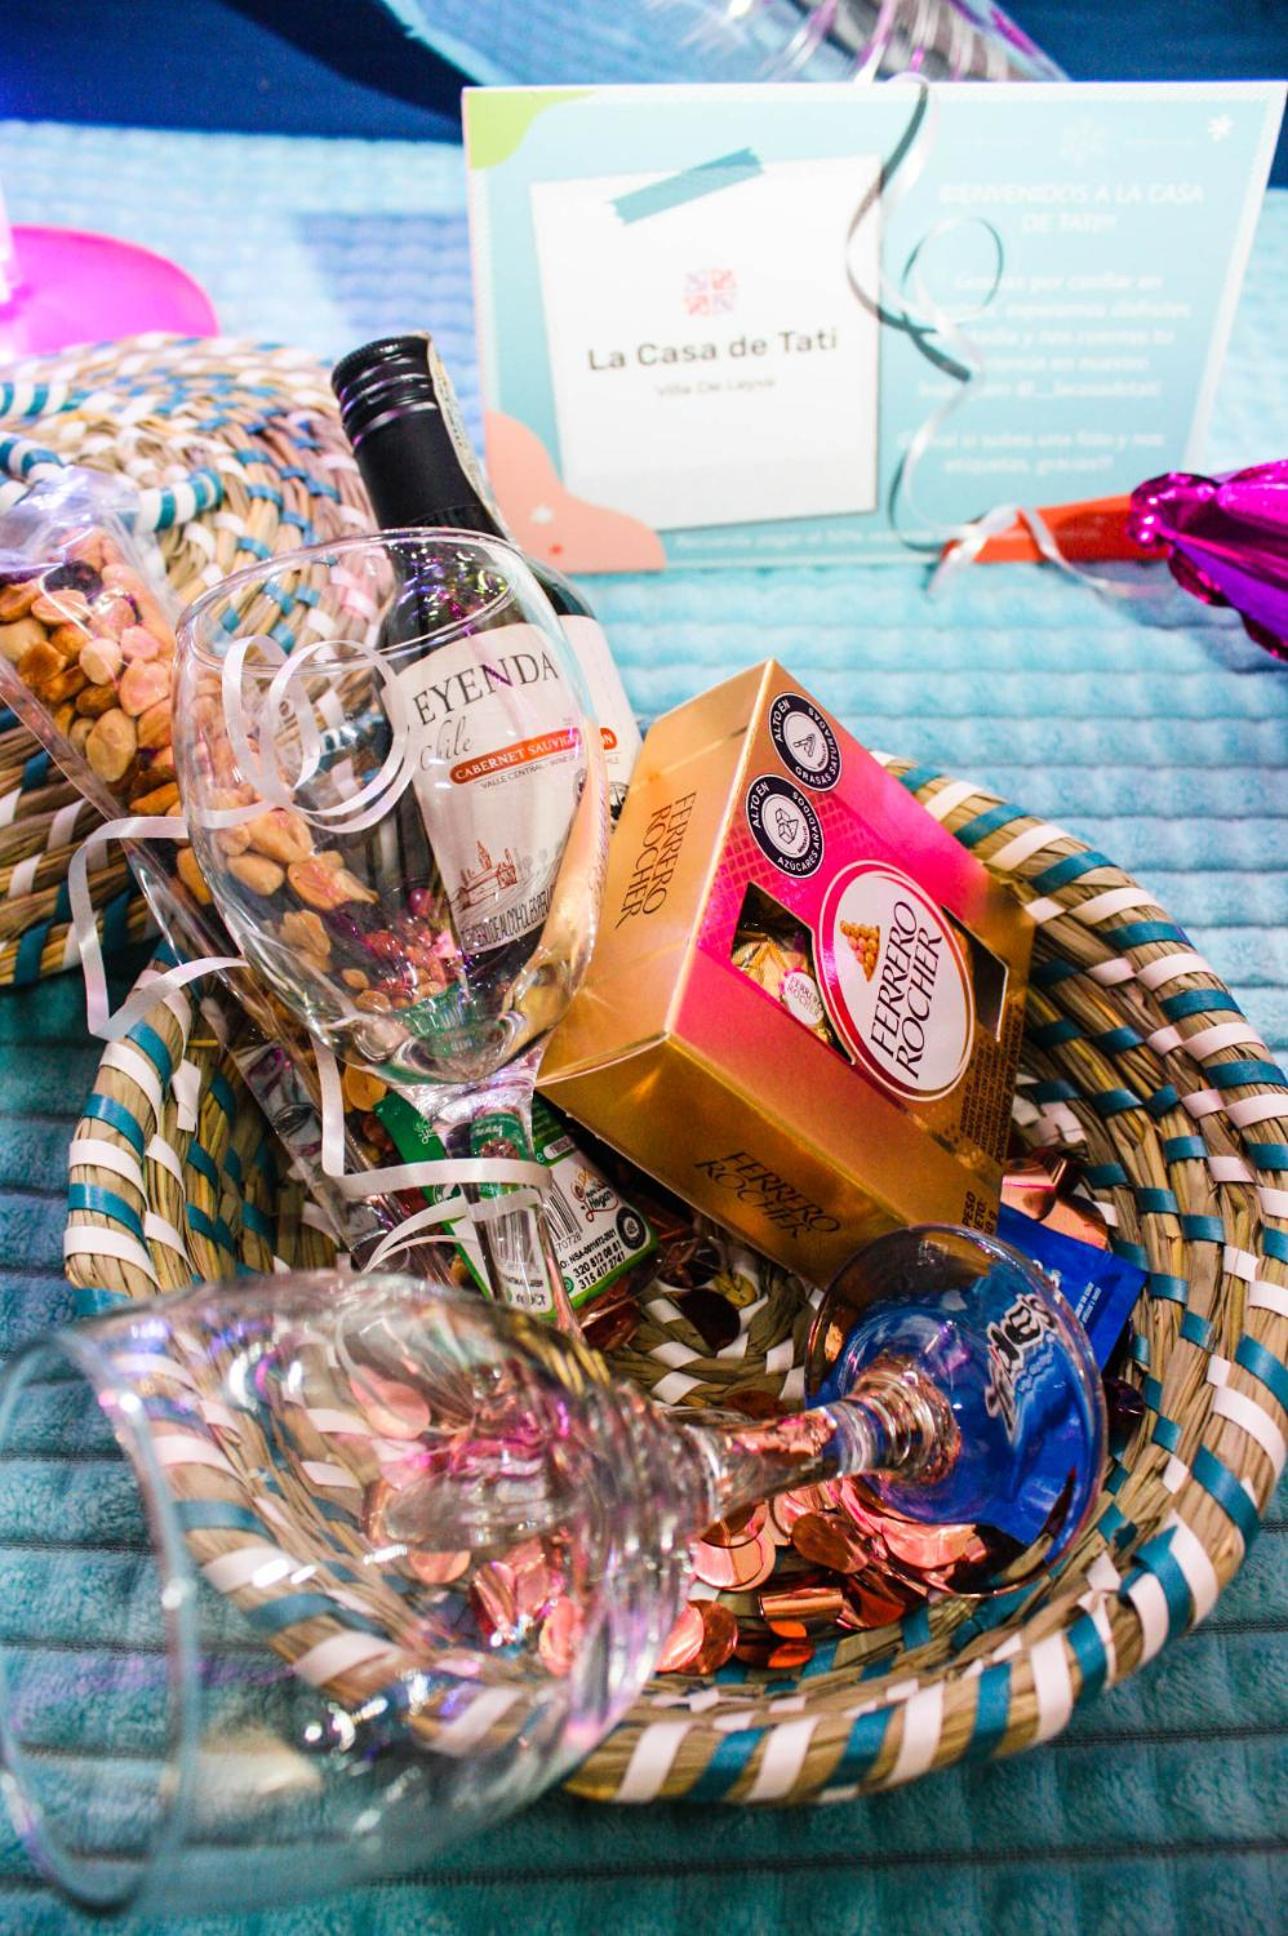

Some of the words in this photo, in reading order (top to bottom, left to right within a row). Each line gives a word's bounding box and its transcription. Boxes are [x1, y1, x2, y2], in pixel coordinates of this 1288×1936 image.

[1149, 183, 1205, 204] CASA
[588, 349, 627, 371] La
[636, 342, 718, 366] Casa
[728, 337, 768, 359] de
[778, 328, 838, 353] Tati
[412, 650, 560, 726] EYENDA
[777, 699, 791, 713] EN
[773, 711, 785, 743] ALTO
[808, 706, 839, 776] SATURADAS
[454, 748, 525, 780] CABERNET
[795, 765, 832, 785] GRASAS
[755, 781, 770, 797] EN
[750, 794, 761, 829] ALTO
[792, 791, 821, 851] AÑADIDOS
[615, 804, 673, 930] ROCHER
[641, 792, 696, 915] FERRERO
[777, 849, 819, 872] AZÚCARES
[870, 900, 919, 1058] FERRERO
[895, 927, 943, 1080] ROCHER
[694, 1160, 812, 1240] ROCHER
[719, 1152, 841, 1233] FERRERO
[961, 1190, 977, 1227] PESO
[578, 1272, 598, 1290] 315
